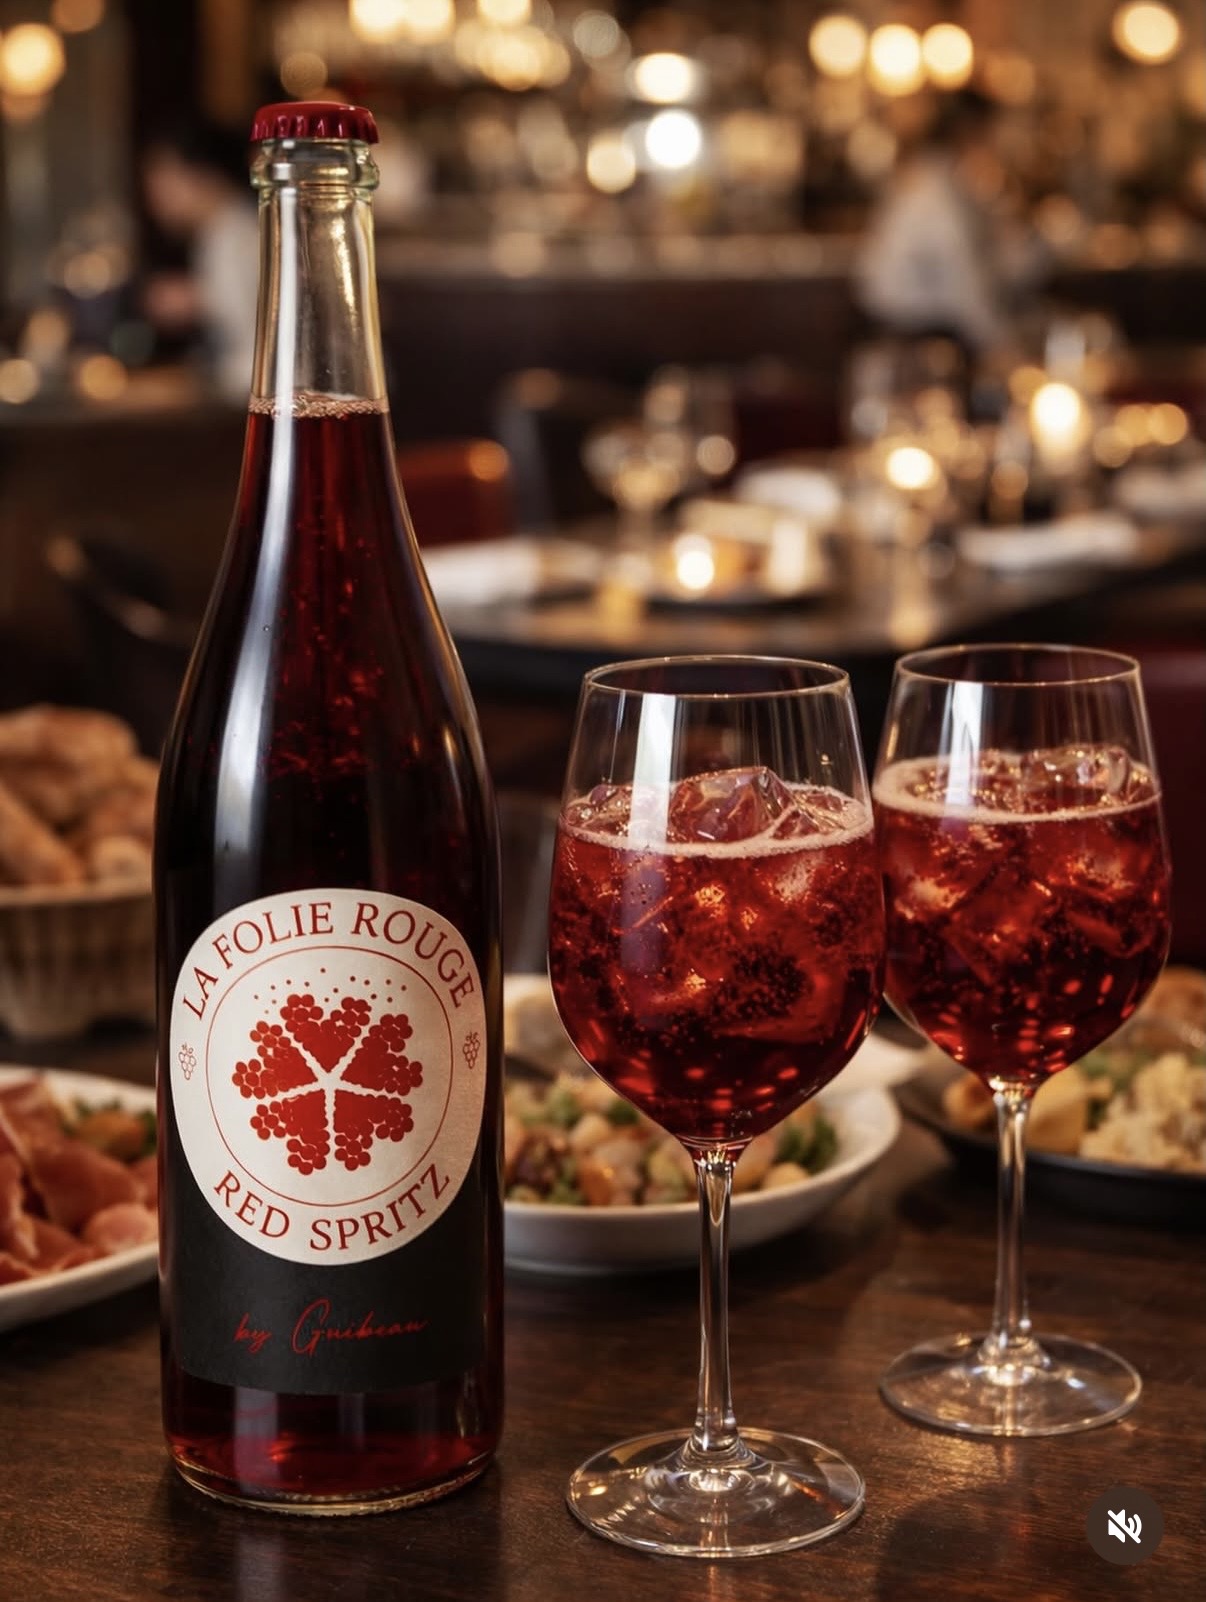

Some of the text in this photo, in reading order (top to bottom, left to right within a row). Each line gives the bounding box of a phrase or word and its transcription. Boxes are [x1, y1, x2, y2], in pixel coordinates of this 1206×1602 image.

[183, 902, 475, 1020] LA FOLIE ROUGE
[213, 1164, 451, 1251] RED SPRITZ
[234, 1313, 272, 1354] by
